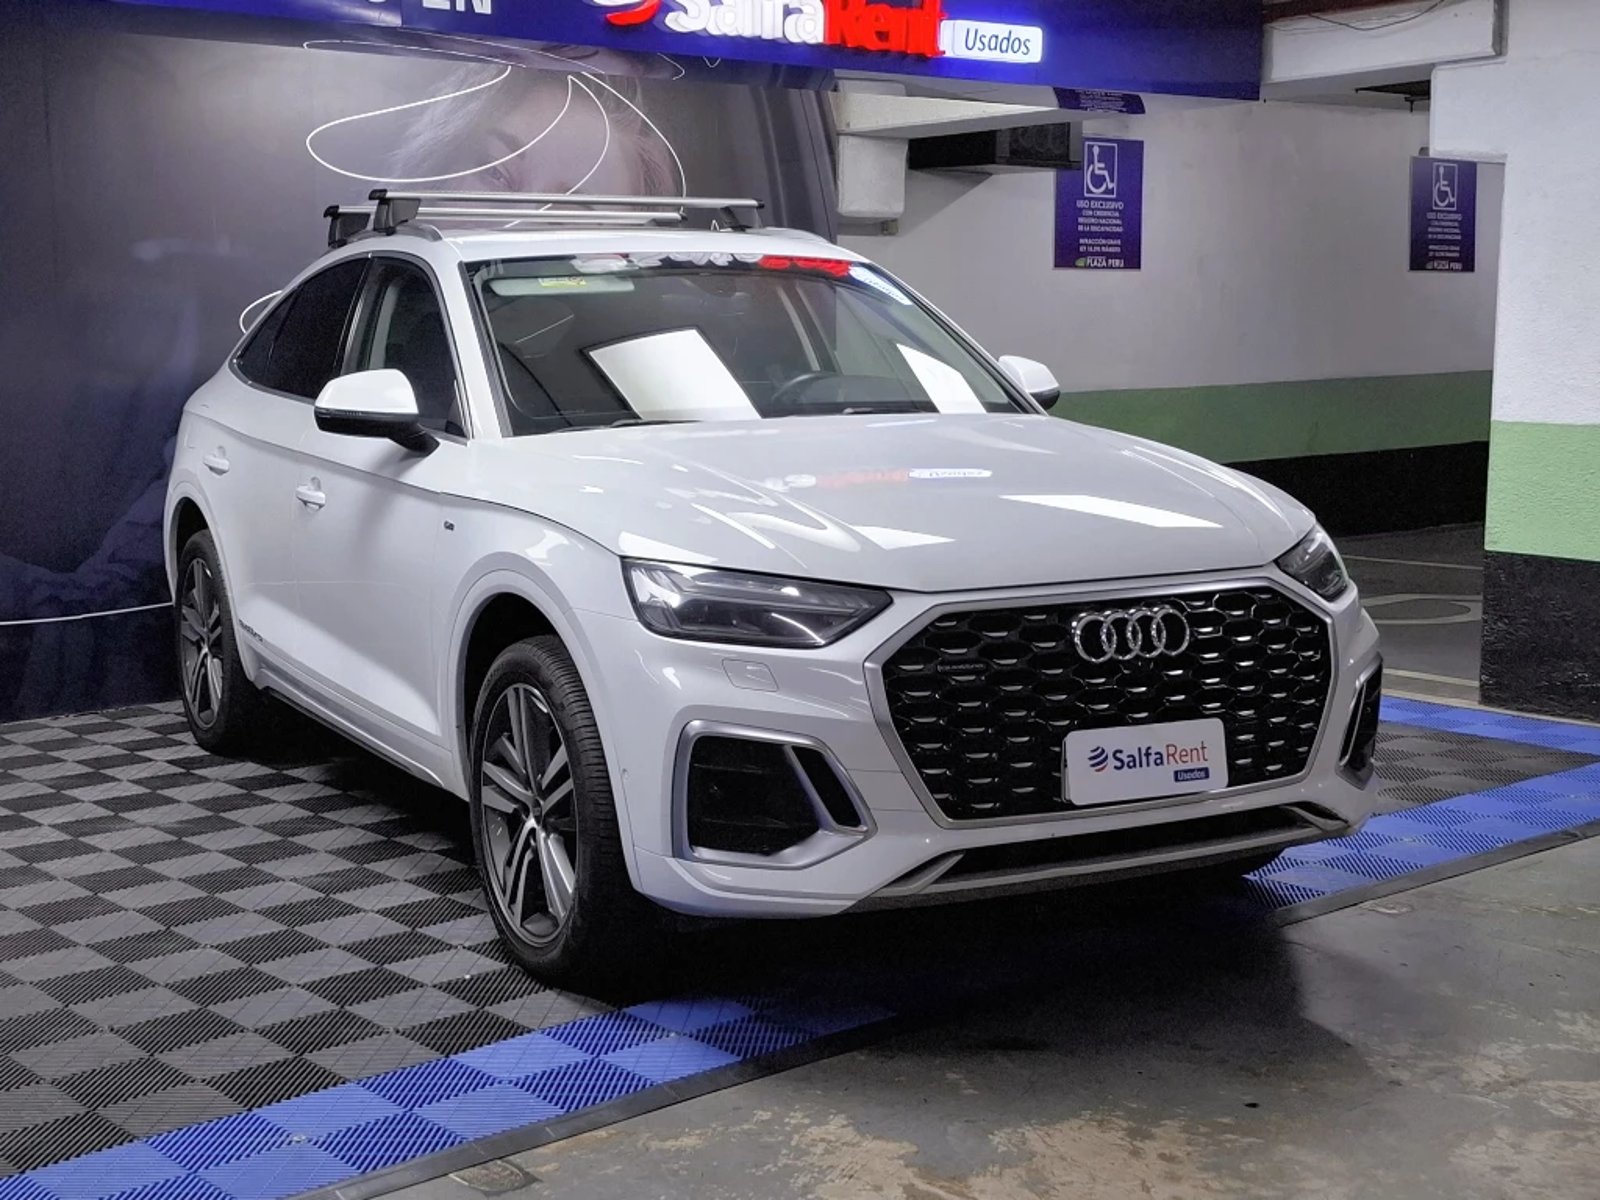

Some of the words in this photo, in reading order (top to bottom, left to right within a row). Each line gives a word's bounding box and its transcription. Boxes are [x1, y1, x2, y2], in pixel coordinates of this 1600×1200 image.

[965, 27, 1031, 55] Usados
[1090, 200, 1124, 210] EXCLUSIVO
[1087, 257, 1107, 267] PLAZA
[1112, 741, 1209, 771] SalfaRent
[1178, 769, 1206, 780] Usados
